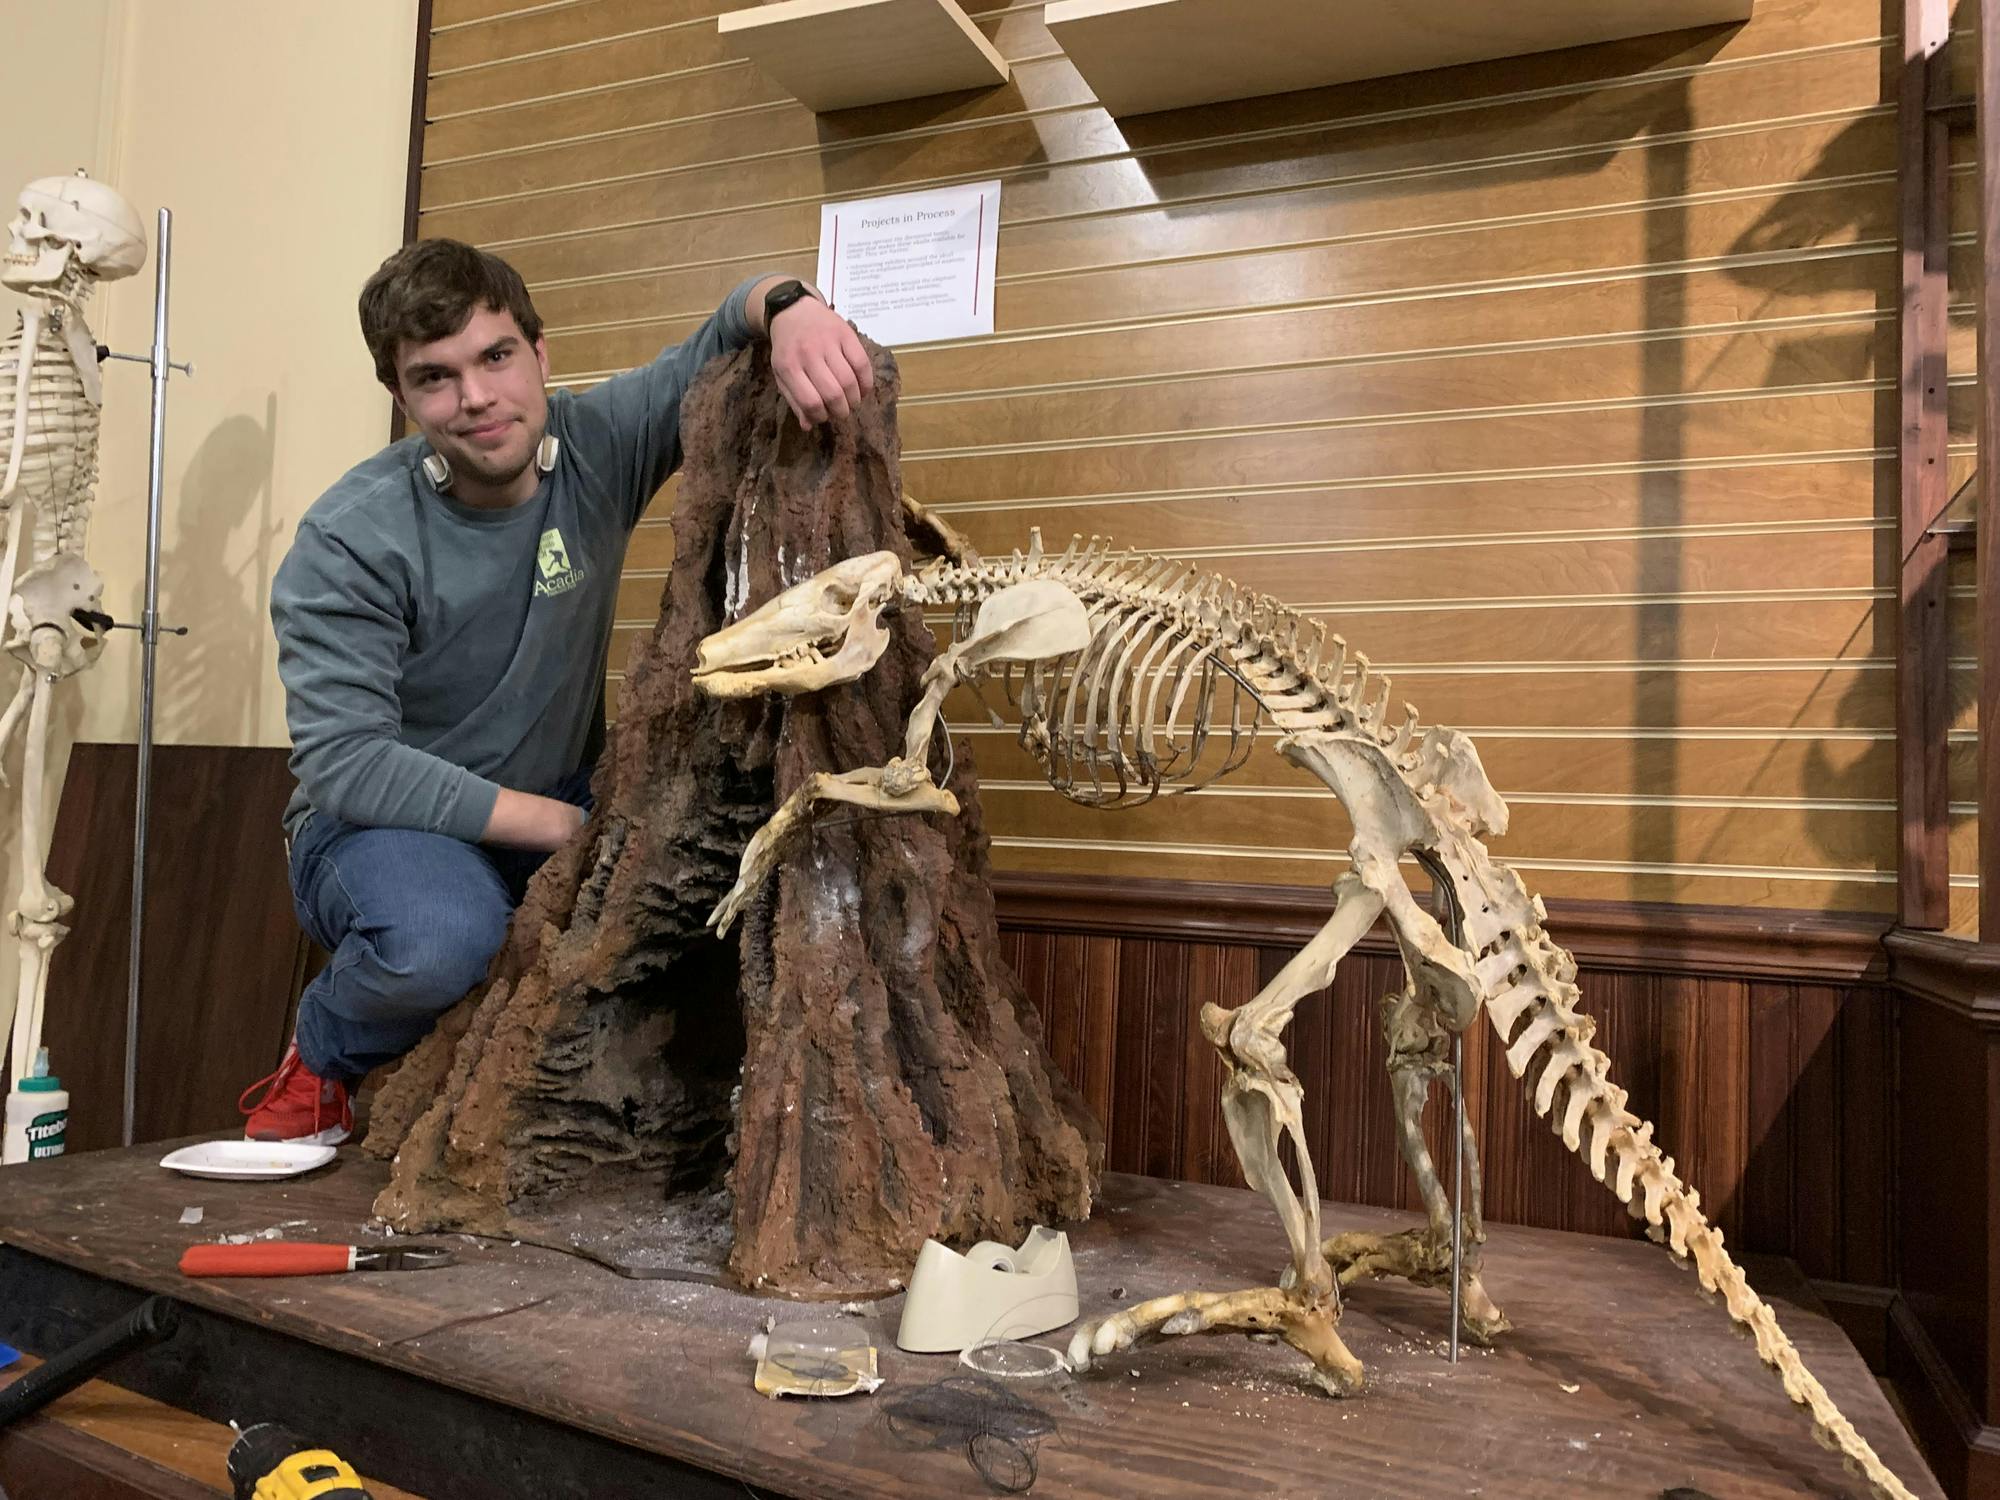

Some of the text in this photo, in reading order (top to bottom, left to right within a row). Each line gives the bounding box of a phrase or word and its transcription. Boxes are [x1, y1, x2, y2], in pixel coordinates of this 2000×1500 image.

[861, 209, 956, 229] Projects in Process
[534, 568, 585, 597] Acadia
